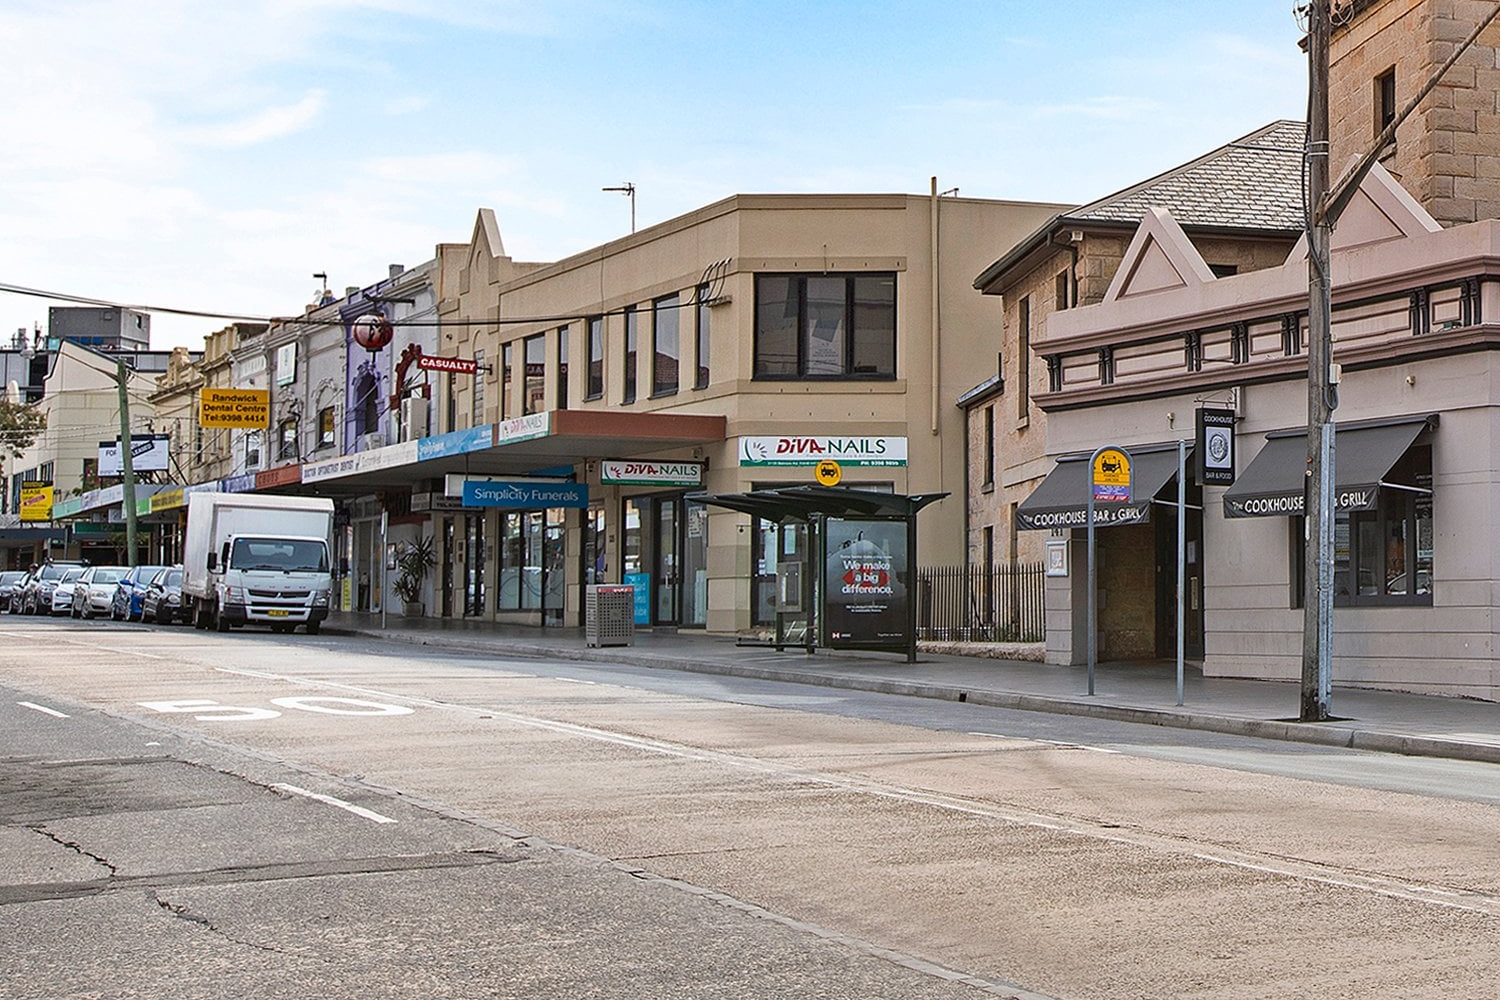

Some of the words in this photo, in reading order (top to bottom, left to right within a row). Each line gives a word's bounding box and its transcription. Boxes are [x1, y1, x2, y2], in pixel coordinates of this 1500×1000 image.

[420, 357, 476, 371] CASUALTY
[212, 393, 258, 402] Randwick
[235, 404, 267, 412] Centre
[1203, 415, 1233, 424] COOKHOUSE
[827, 439, 886, 454] NAILS
[660, 465, 698, 476] NAILS
[474, 487, 530, 502] Simplicity
[531, 489, 579, 501] Funerals
[1232, 501, 1244, 511] The
[1244, 496, 1304, 513] COOKHOUSE
[1340, 491, 1368, 507] GRILL
[1033, 510, 1087, 526] COOKHOUSE
[1117, 507, 1142, 520] GRILL
[842, 561, 861, 570] We
[862, 560, 890, 570] make
[863, 572, 879, 584] big
[841, 584, 894, 594] difference.
[138, 695, 414, 722] 50
